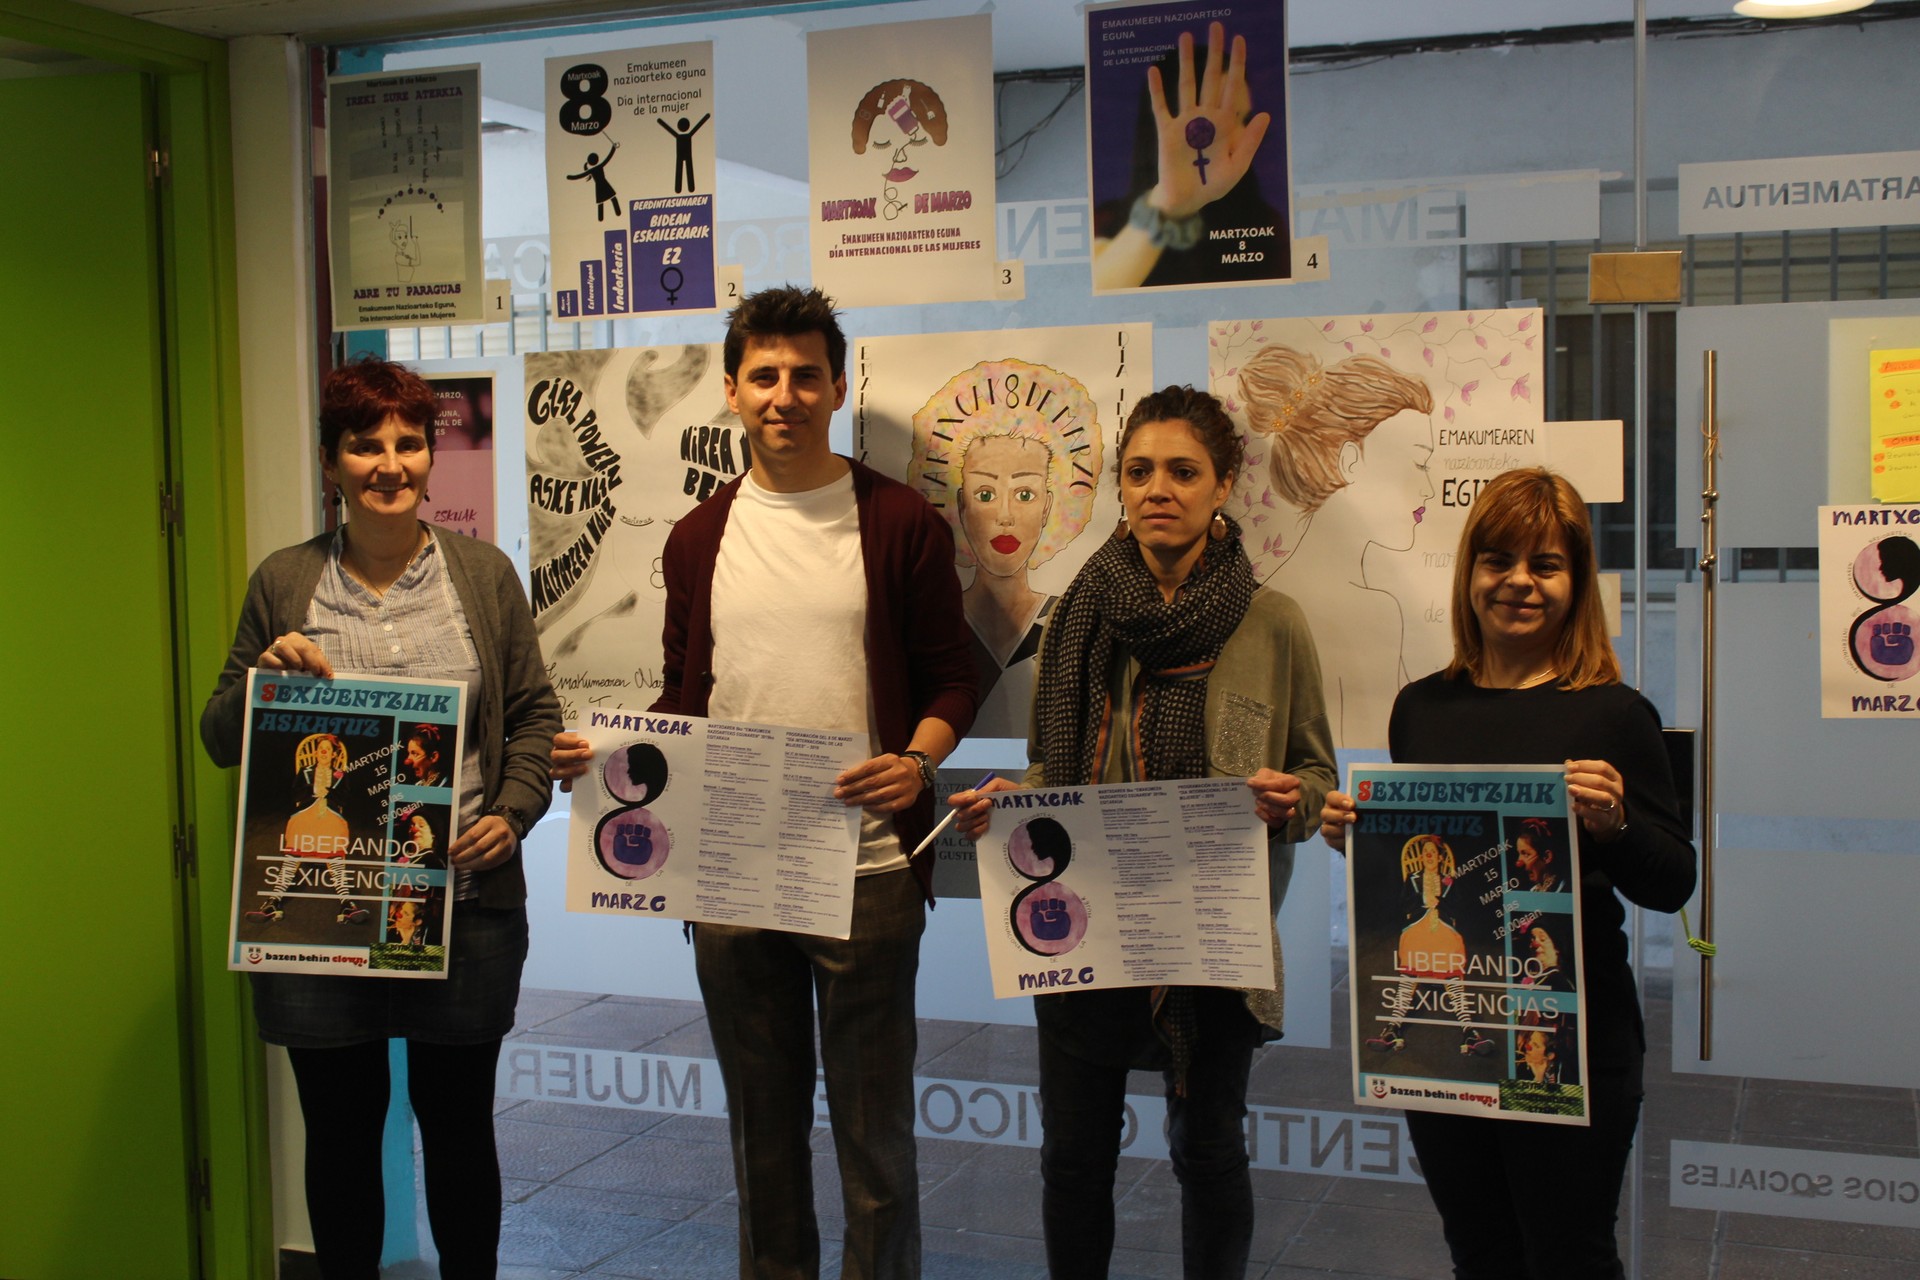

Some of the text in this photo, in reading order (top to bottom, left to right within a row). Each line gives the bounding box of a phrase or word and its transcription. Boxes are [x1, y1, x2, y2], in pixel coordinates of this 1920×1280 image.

[1102, 8, 1232, 29] EMAKUMEEN NAZIOARTEKO
[1102, 31, 1136, 42] EGUNA
[1117, 43, 1177, 56] INTERNACIONAL
[627, 58, 687, 74] Emakumeen
[1103, 54, 1166, 67] DE LAS MUJERES
[568, 70, 601, 82] Martxoak
[613, 68, 706, 87] nazioarteko eguna
[415, 86, 464, 102] ATERKIA
[559, 63, 612, 136] 8
[617, 88, 702, 107] Día internacional
[633, 101, 690, 116] de la mujer
[571, 120, 600, 132] Marzo
[633, 196, 709, 211] BERDINTASUNAREN
[821, 190, 972, 222] MARTXOAK DE MARZO
[650, 212, 692, 228] BIDEAN
[633, 225, 710, 243] ESKAILERARIK
[936, 227, 961, 240] EGUNA
[1209, 226, 1275, 240] MARTXOAK
[845, 244, 912, 258] INTERNACIONAL
[913, 243, 924, 253] DE
[924, 241, 941, 253] LAS
[942, 239, 981, 252] MUJERES
[1239, 240, 1247, 251] 8
[662, 246, 683, 265] EZ
[1221, 251, 1264, 264] MARZO
[1306, 252, 1318, 269] 4
[613, 242, 625, 311] Indarkeria
[1002, 268, 1012, 285] 3
[353, 283, 461, 300] ABRE TU PARAGUAS
[727, 282, 737, 297] 2
[358, 300, 456, 313] Emakumeen Nazioarteko Eguna,
[496, 295, 504, 310] 1
[369, 313, 409, 323] Internacional
[409, 313, 418, 321] de
[419, 312, 428, 320] las
[429, 311, 456, 321] Mujeres
[1004, 373, 1019, 409] 8
[452, 418, 463, 427] DE
[1439, 428, 1535, 447] EMAKUMEAREN
[1443, 455, 1520, 472] nazioarteko
[530, 473, 578, 515] ASKE
[1425, 600, 1444, 624] de
[261, 683, 453, 714] SEXIJENTZIAK
[257, 711, 381, 738] ASKATUZ
[591, 712, 693, 736] MARTXOAK
[344, 740, 405, 774] MARTXOAK
[374, 764, 388, 777] 15
[367, 772, 407, 797] MARZO
[1358, 780, 1557, 806] SEXIJENTZIAK
[381, 790, 405, 808] a las
[1359, 813, 1484, 837] ASKATUZ
[279, 833, 420, 859] LIBERANDO
[941, 837, 953, 847] AL
[1453, 838, 1513, 881] MARTXOAK
[264, 865, 430, 893] SEXIGENCIAS
[1484, 867, 1499, 883] 15
[1479, 877, 1520, 906] MARZO
[591, 891, 666, 912] MARZO
[1495, 899, 1520, 920] a las
[265, 952, 297, 962] bazen
[298, 952, 330, 964] behin
[1393, 950, 1544, 979] LIBERANDO
[1019, 966, 1094, 990] MARZO
[1381, 987, 1559, 1020] SEXIGENCIAS
[1390, 1084, 1424, 1098] bazen
[1424, 1087, 1458, 1102] behin
